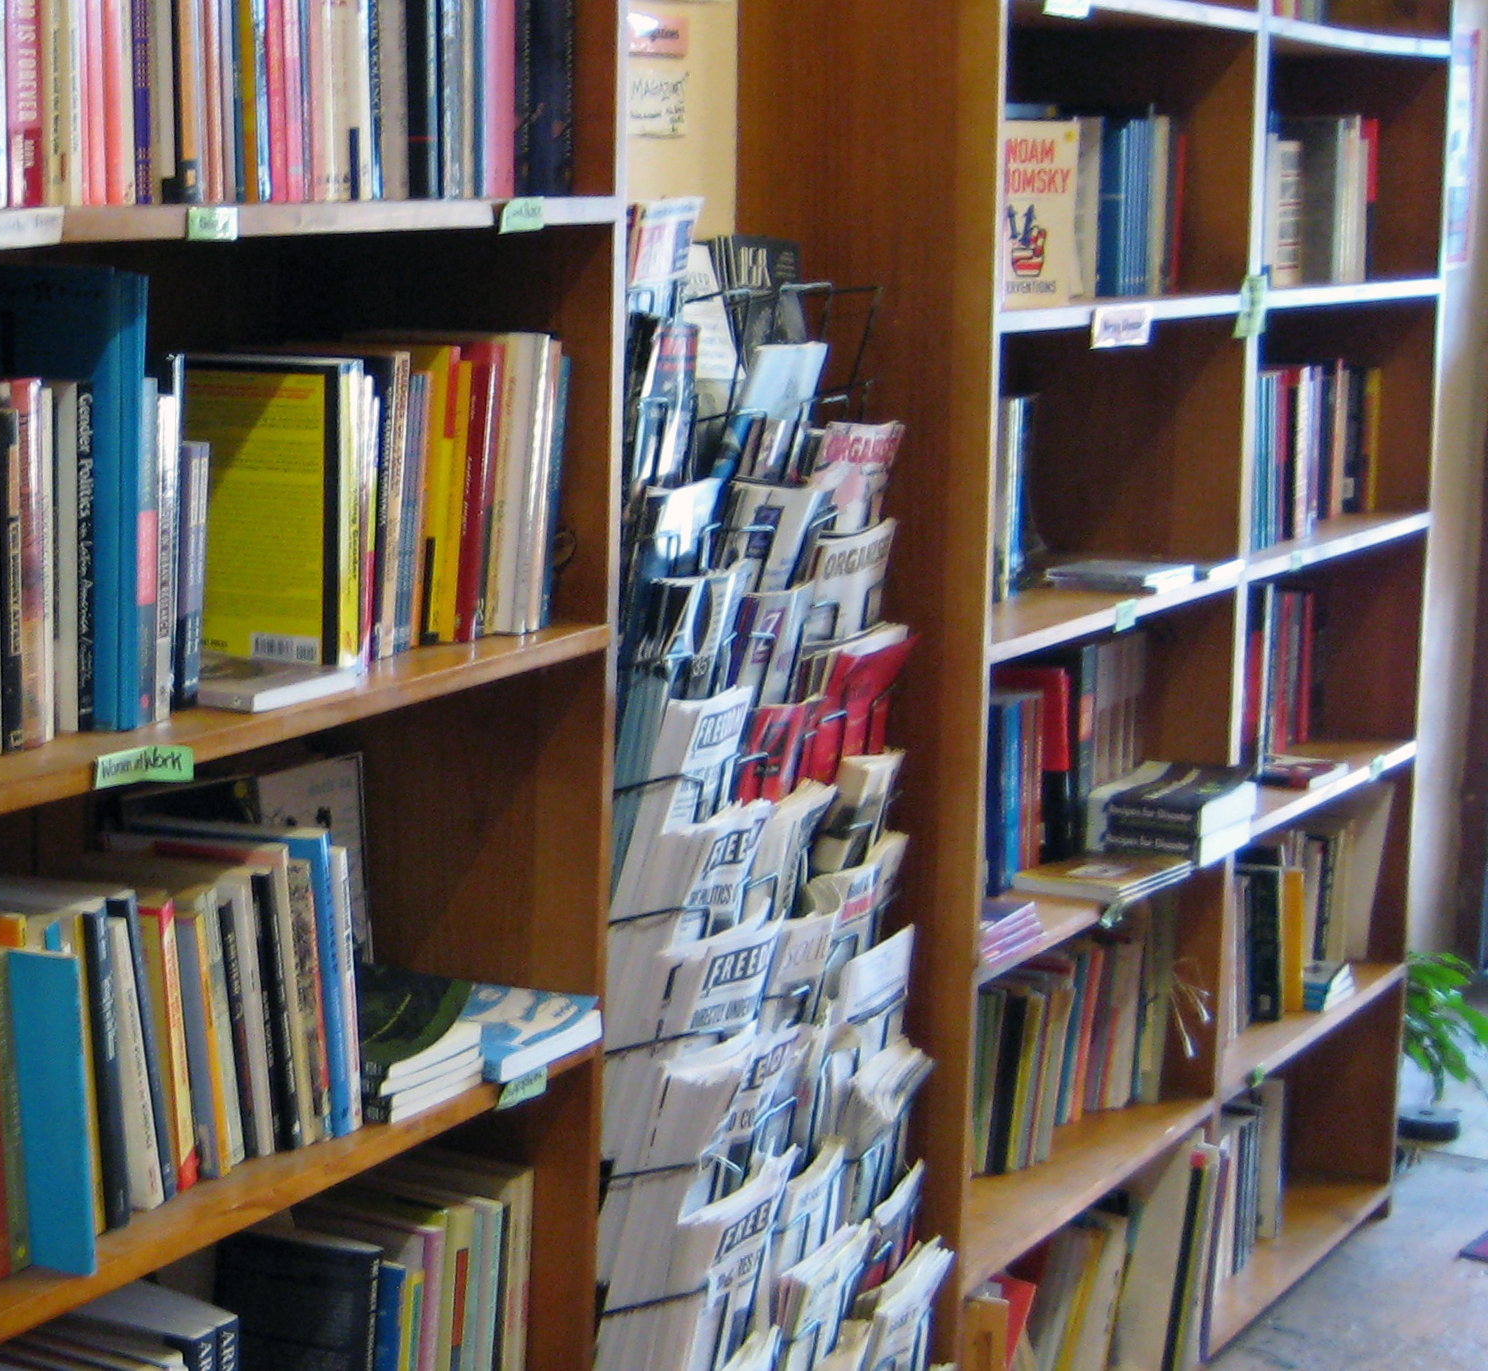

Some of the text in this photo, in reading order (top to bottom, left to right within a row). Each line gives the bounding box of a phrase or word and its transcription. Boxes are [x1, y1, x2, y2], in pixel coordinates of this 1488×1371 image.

[18, 48, 38, 122] FOREVER
[78, 393, 93, 453] Gender
[77, 457, 94, 517] Politics
[82, 519, 92, 536] in
[78, 540, 93, 577] Latin
[77, 579, 94, 634] America
[101, 760, 132, 779] Women
[145, 747, 182, 772] Work
